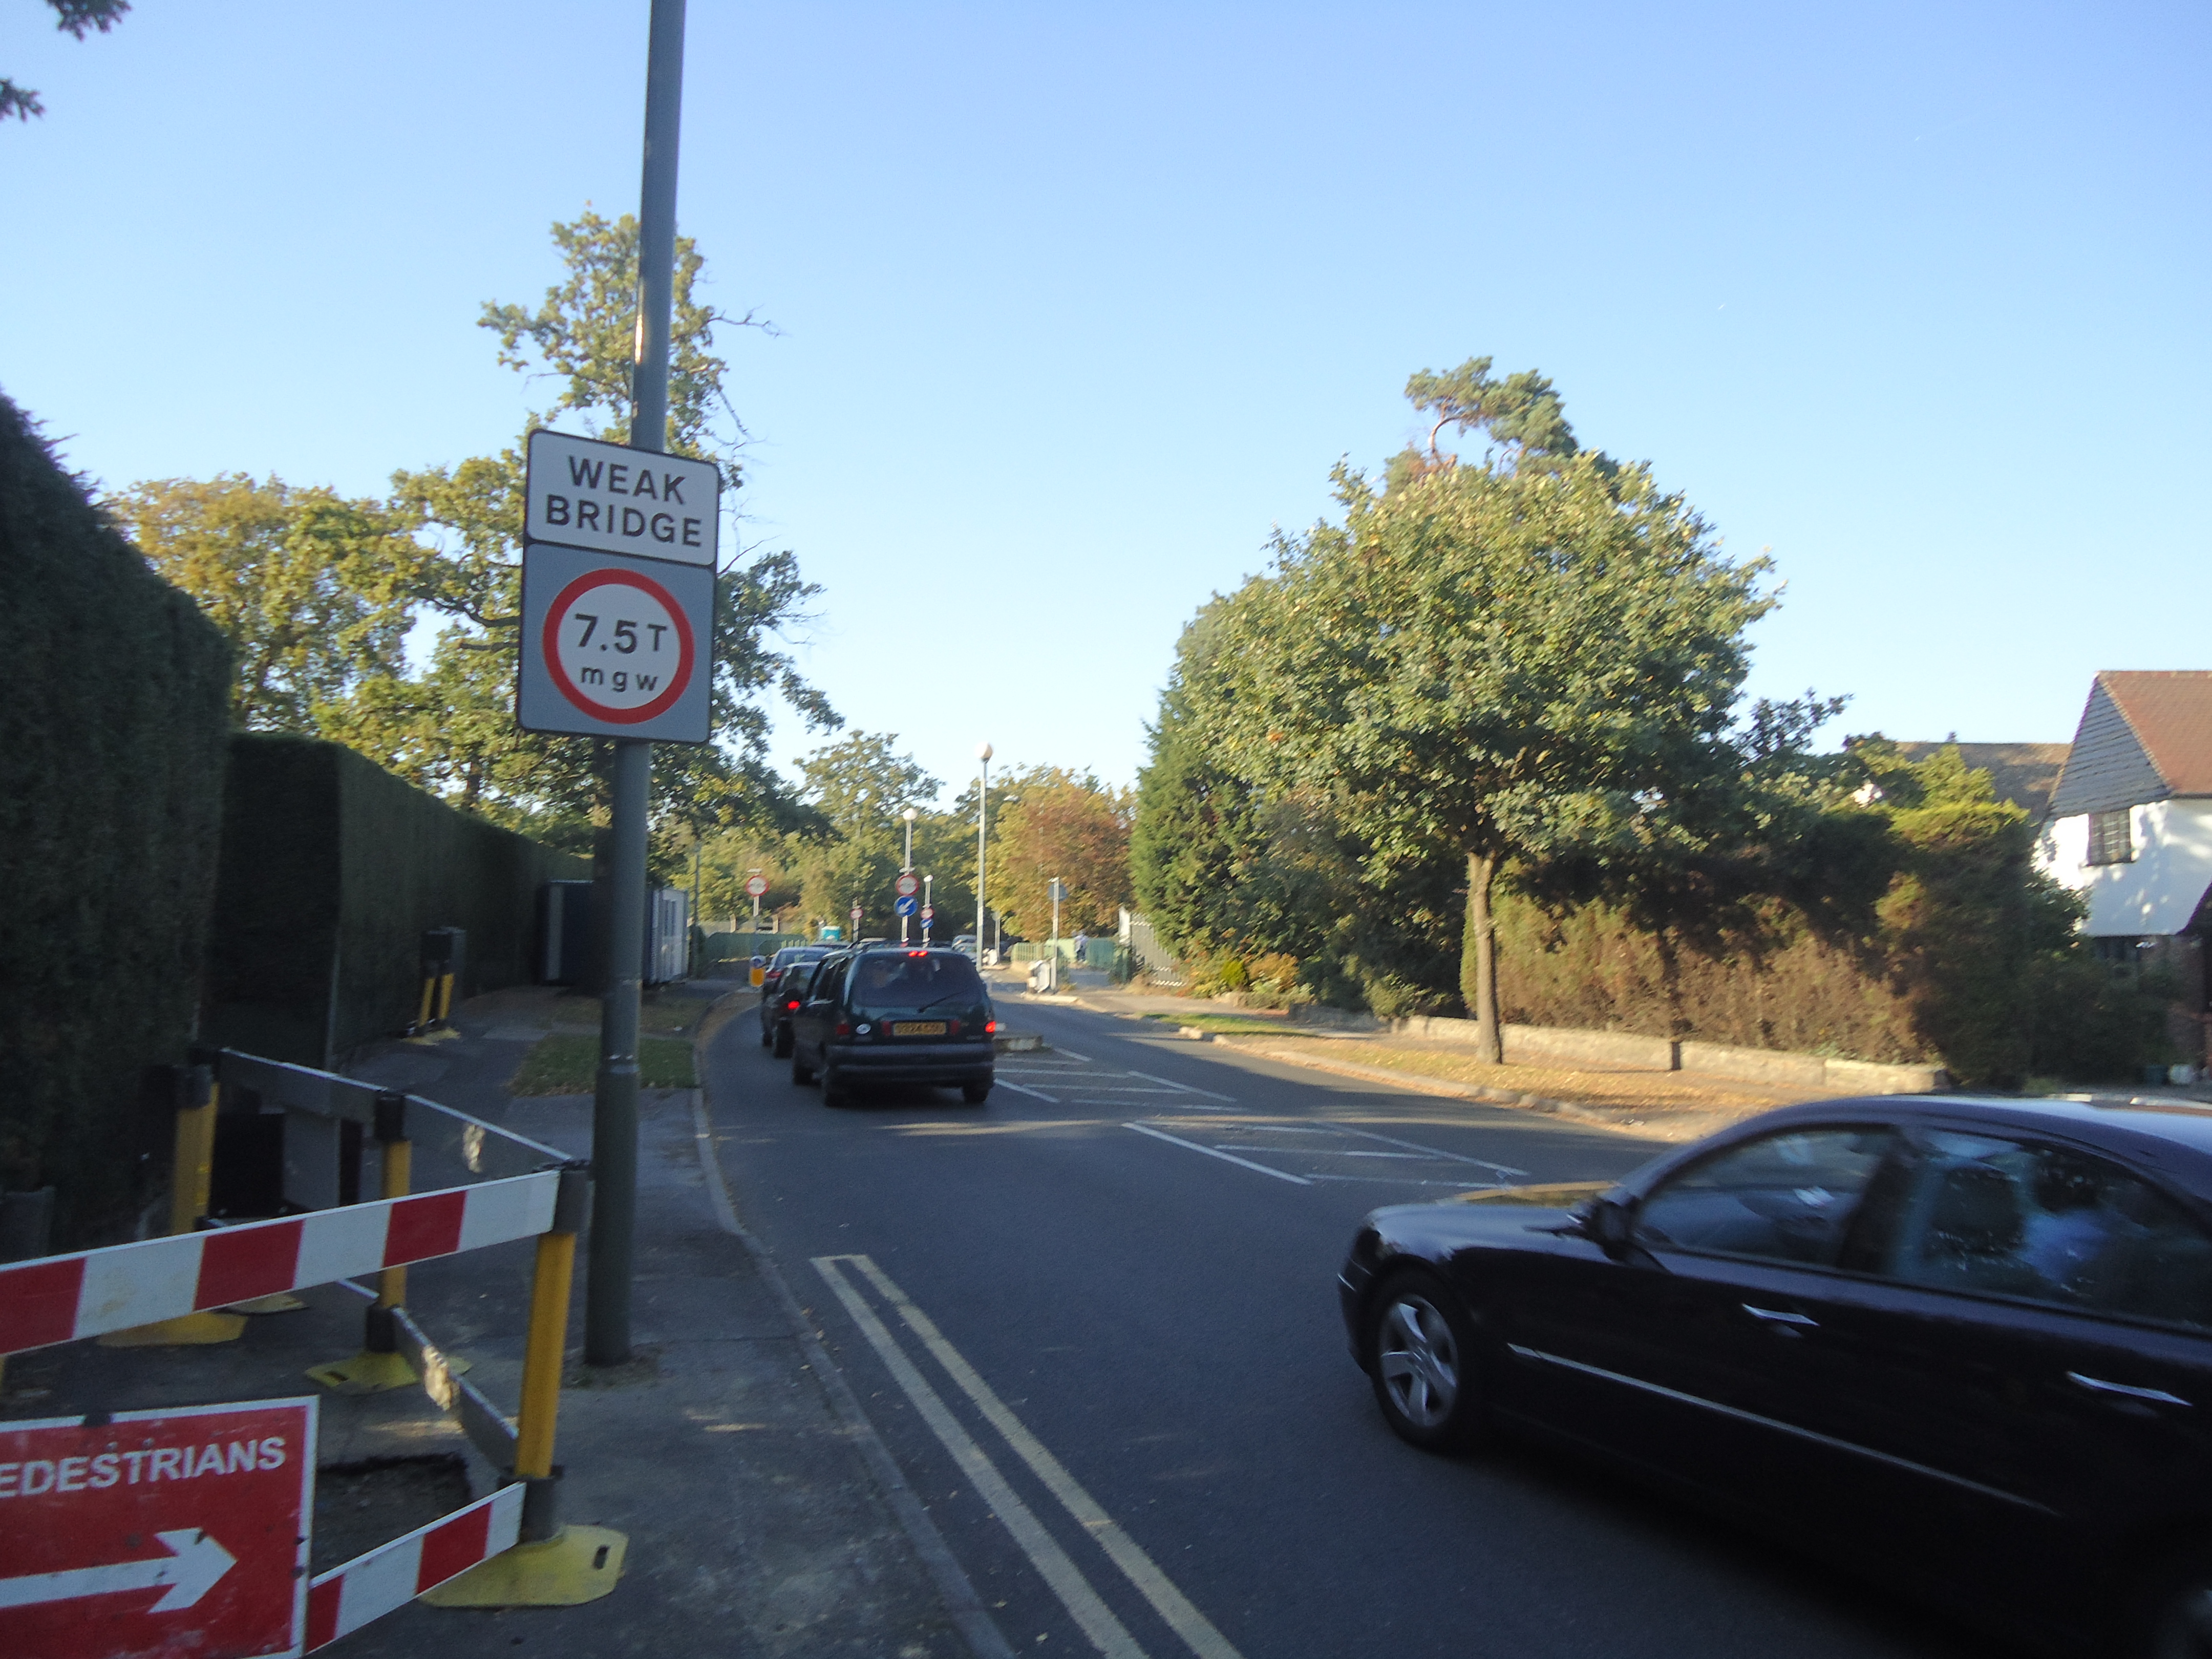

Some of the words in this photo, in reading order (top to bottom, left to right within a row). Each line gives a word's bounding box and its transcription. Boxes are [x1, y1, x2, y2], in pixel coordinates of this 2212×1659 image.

[569, 456, 686, 505] WEAK
[546, 495, 701, 547] BRIDGE
[575, 613, 667, 653] 7.5T
[581, 666, 658, 692] mgw
